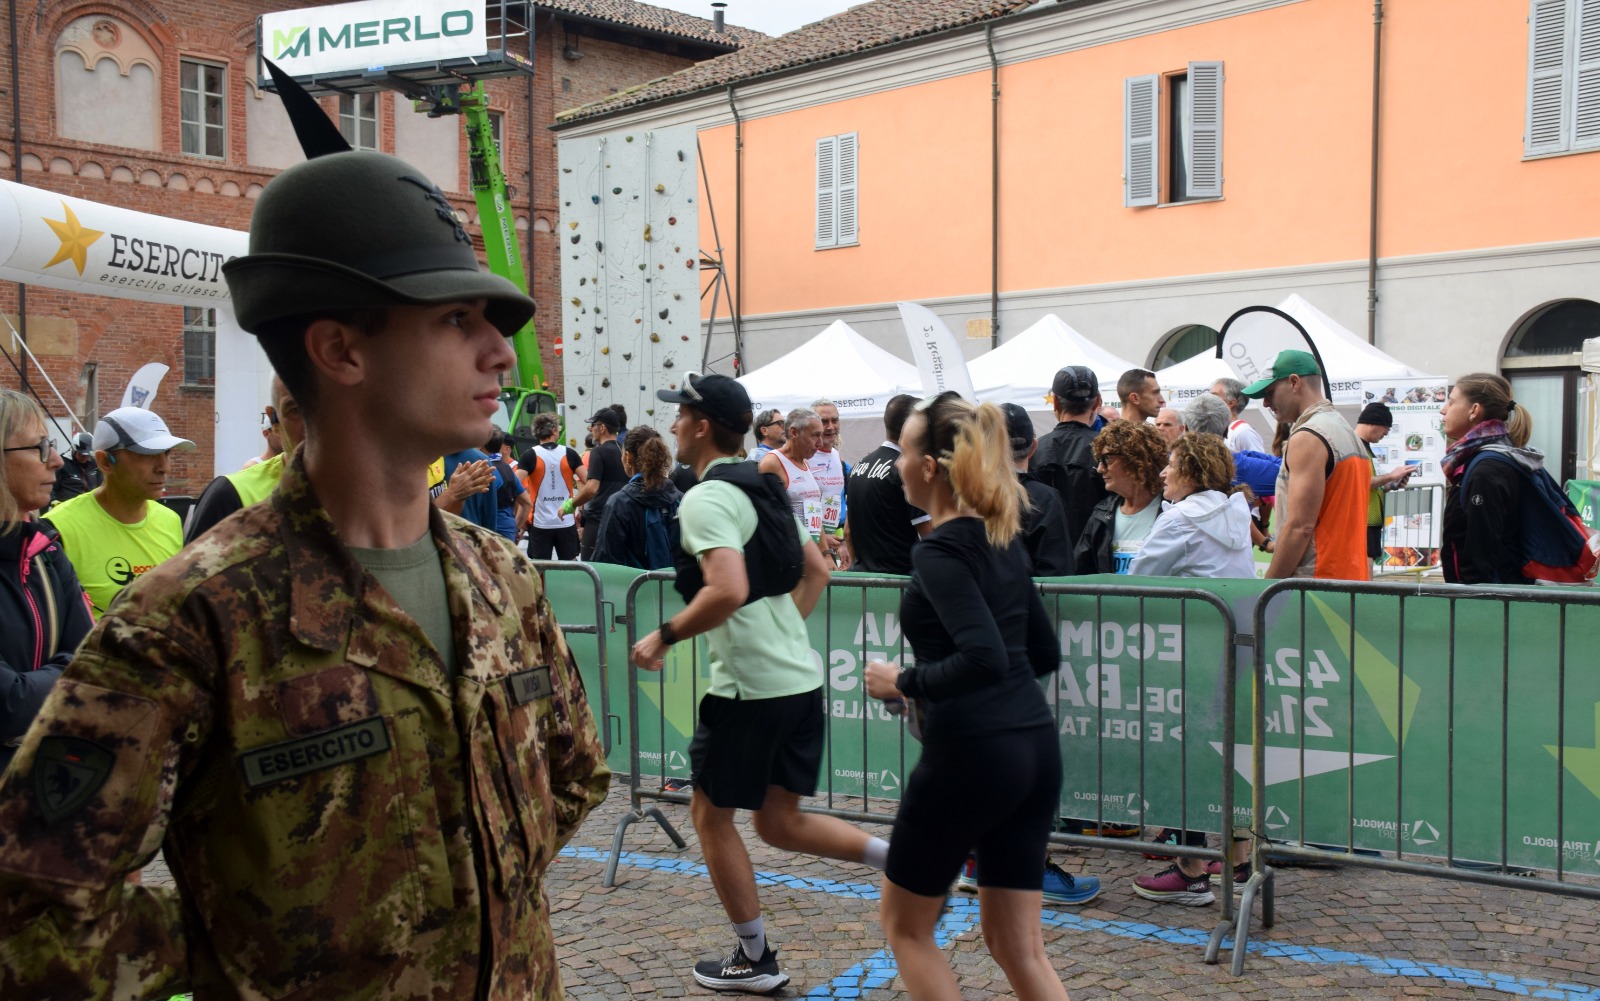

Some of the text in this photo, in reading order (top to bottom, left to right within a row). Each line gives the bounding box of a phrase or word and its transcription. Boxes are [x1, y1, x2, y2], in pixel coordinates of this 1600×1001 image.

[319, 9, 473, 51] MERLO
[108, 233, 239, 283] ESERCIT
[824, 507, 838, 521] 310
[258, 729, 375, 776] ESERCITO
[1187, 880, 1205, 892] HOKA
